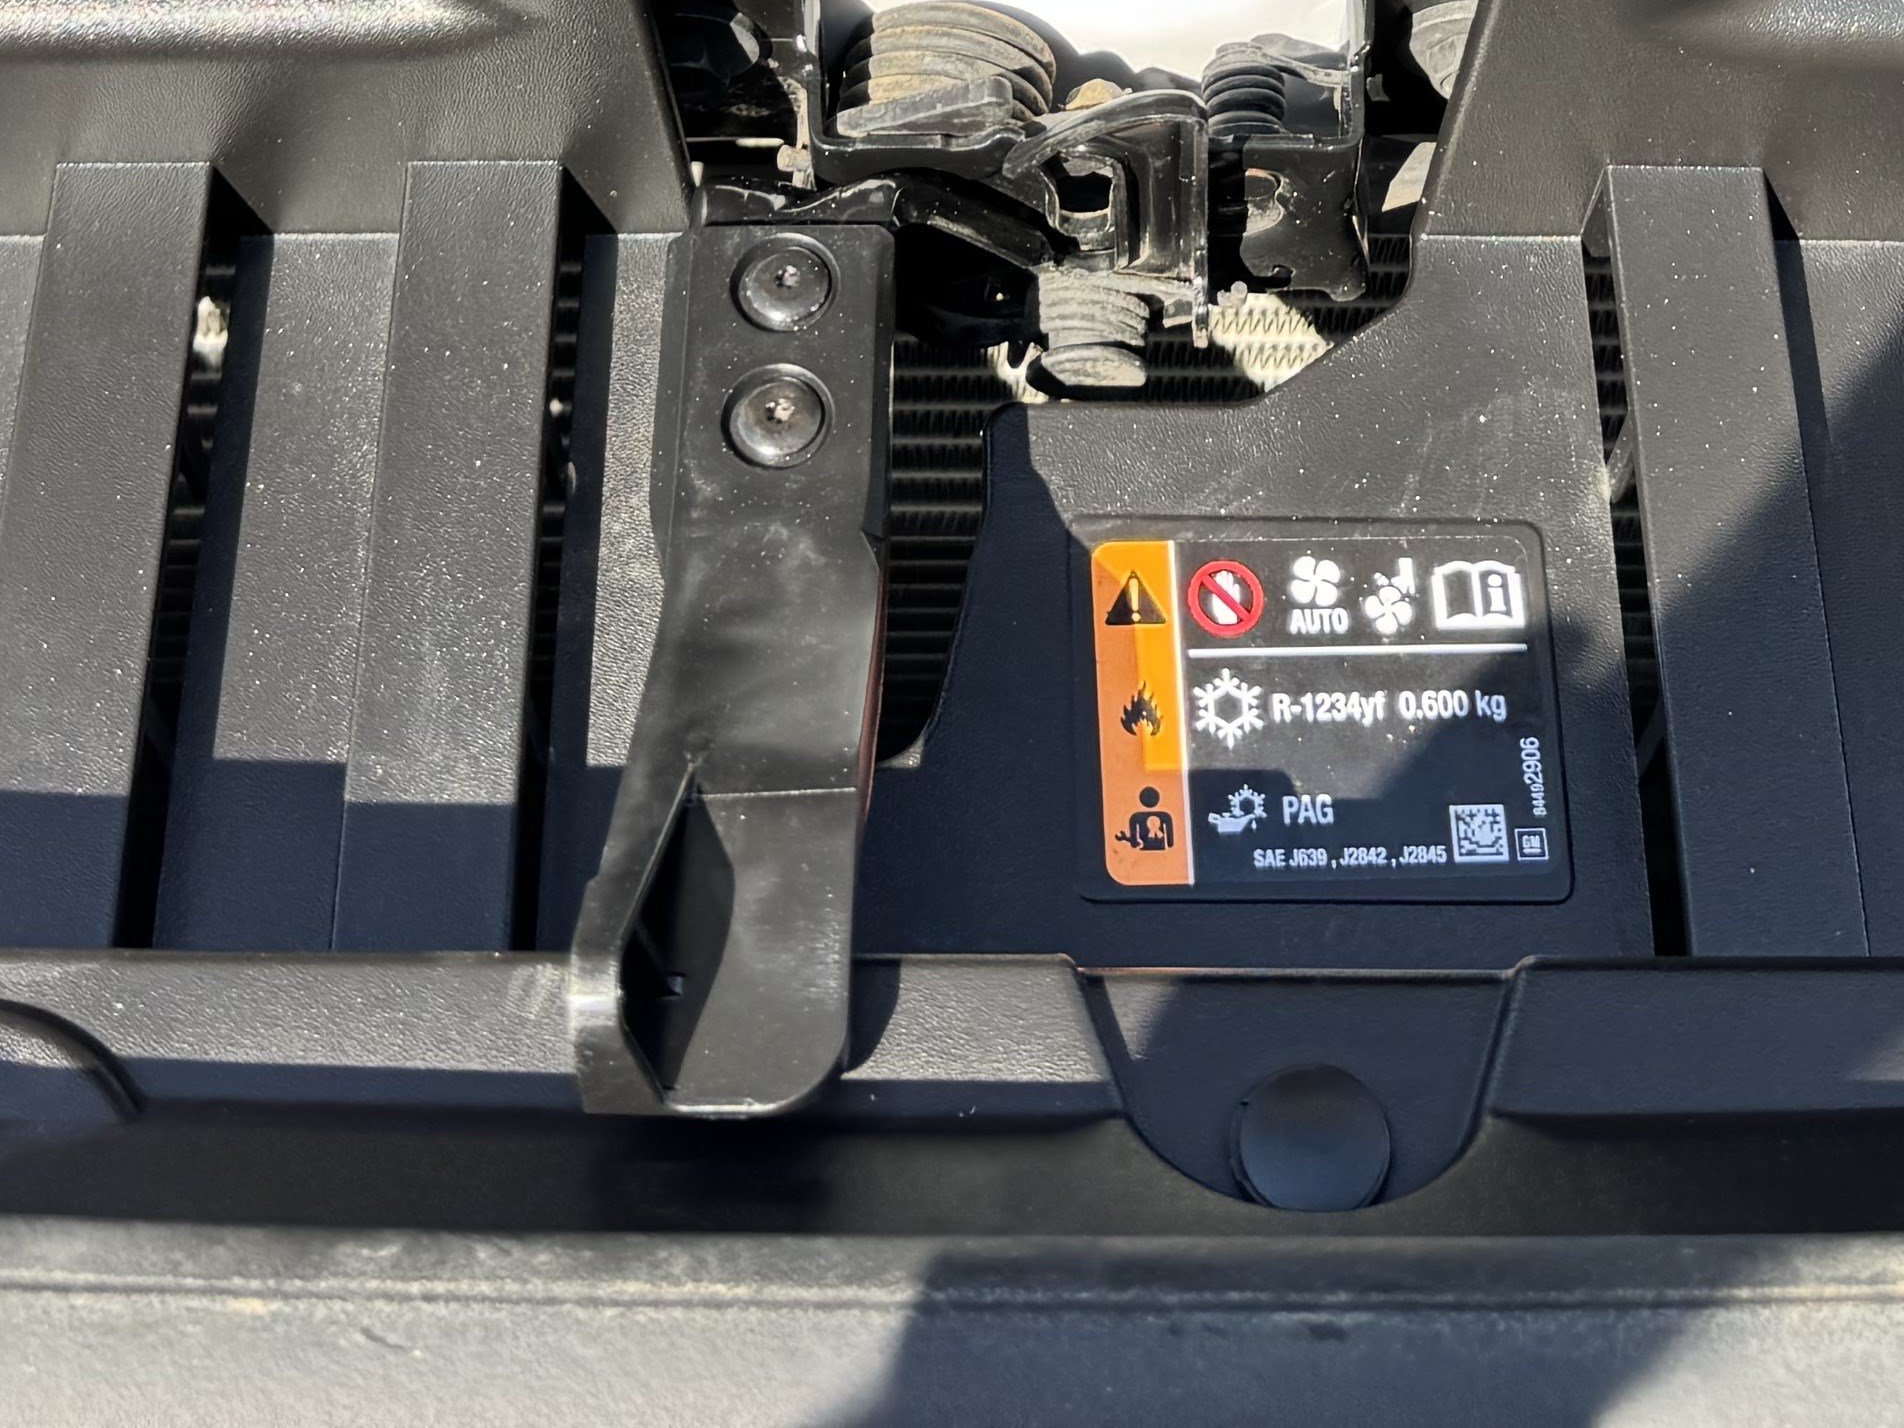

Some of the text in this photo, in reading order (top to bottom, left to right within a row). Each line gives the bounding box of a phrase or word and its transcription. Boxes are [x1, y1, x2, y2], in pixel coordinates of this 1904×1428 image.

[1289, 607, 1349, 635] AUTO
[1271, 688, 1508, 728] R-1234yf 0.600 kg
[1282, 793, 1334, 826] PAG
[1253, 848, 1286, 868] SAE
[1398, 844, 1448, 865] J2845
